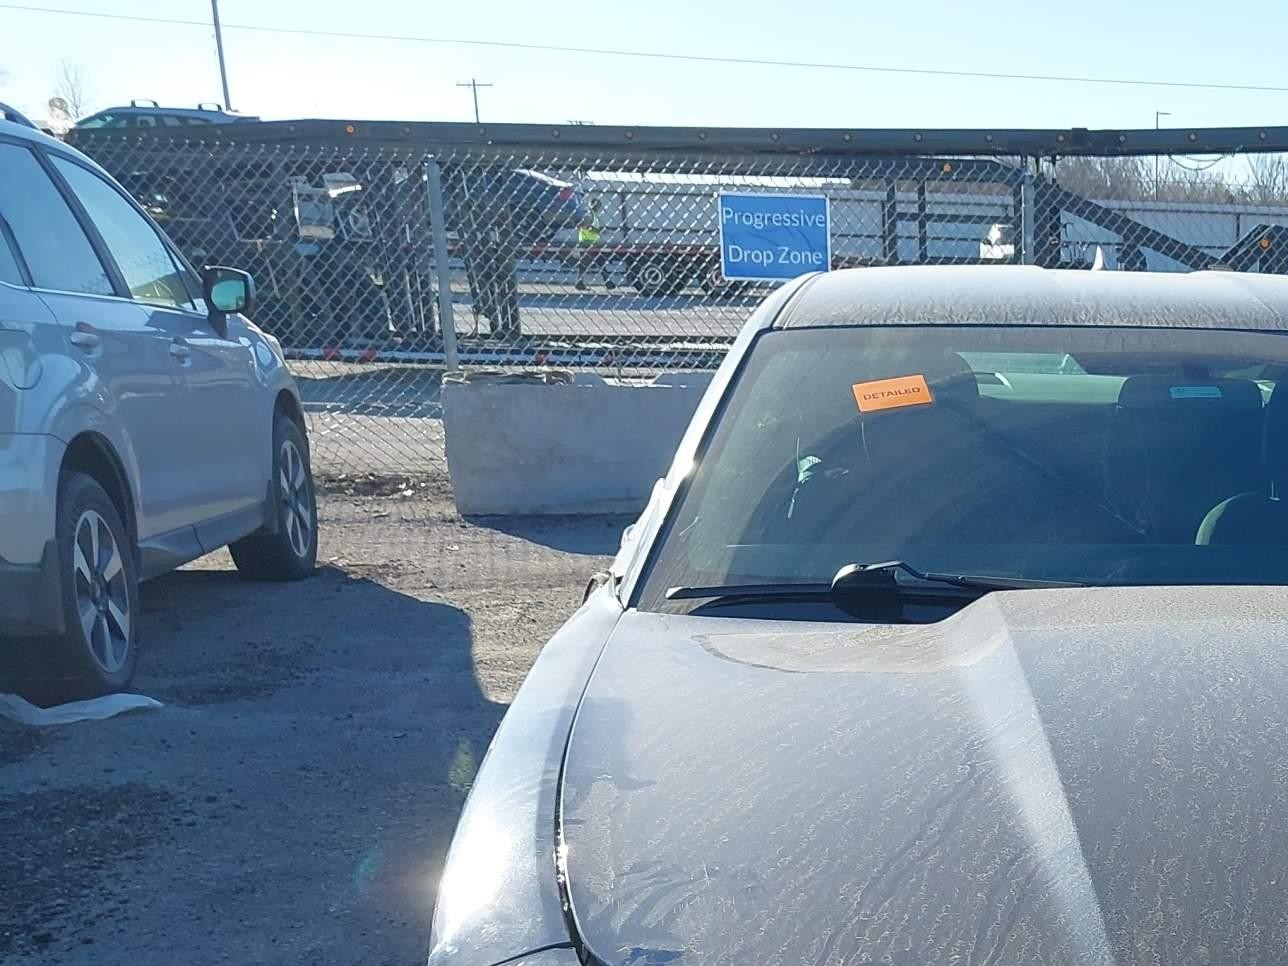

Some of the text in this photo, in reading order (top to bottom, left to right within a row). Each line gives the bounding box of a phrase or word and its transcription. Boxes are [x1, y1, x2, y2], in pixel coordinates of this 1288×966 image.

[722, 207, 826, 229] Progressive
[728, 245, 823, 267] Drop Zone
[863, 386, 921, 401] DETAILED
